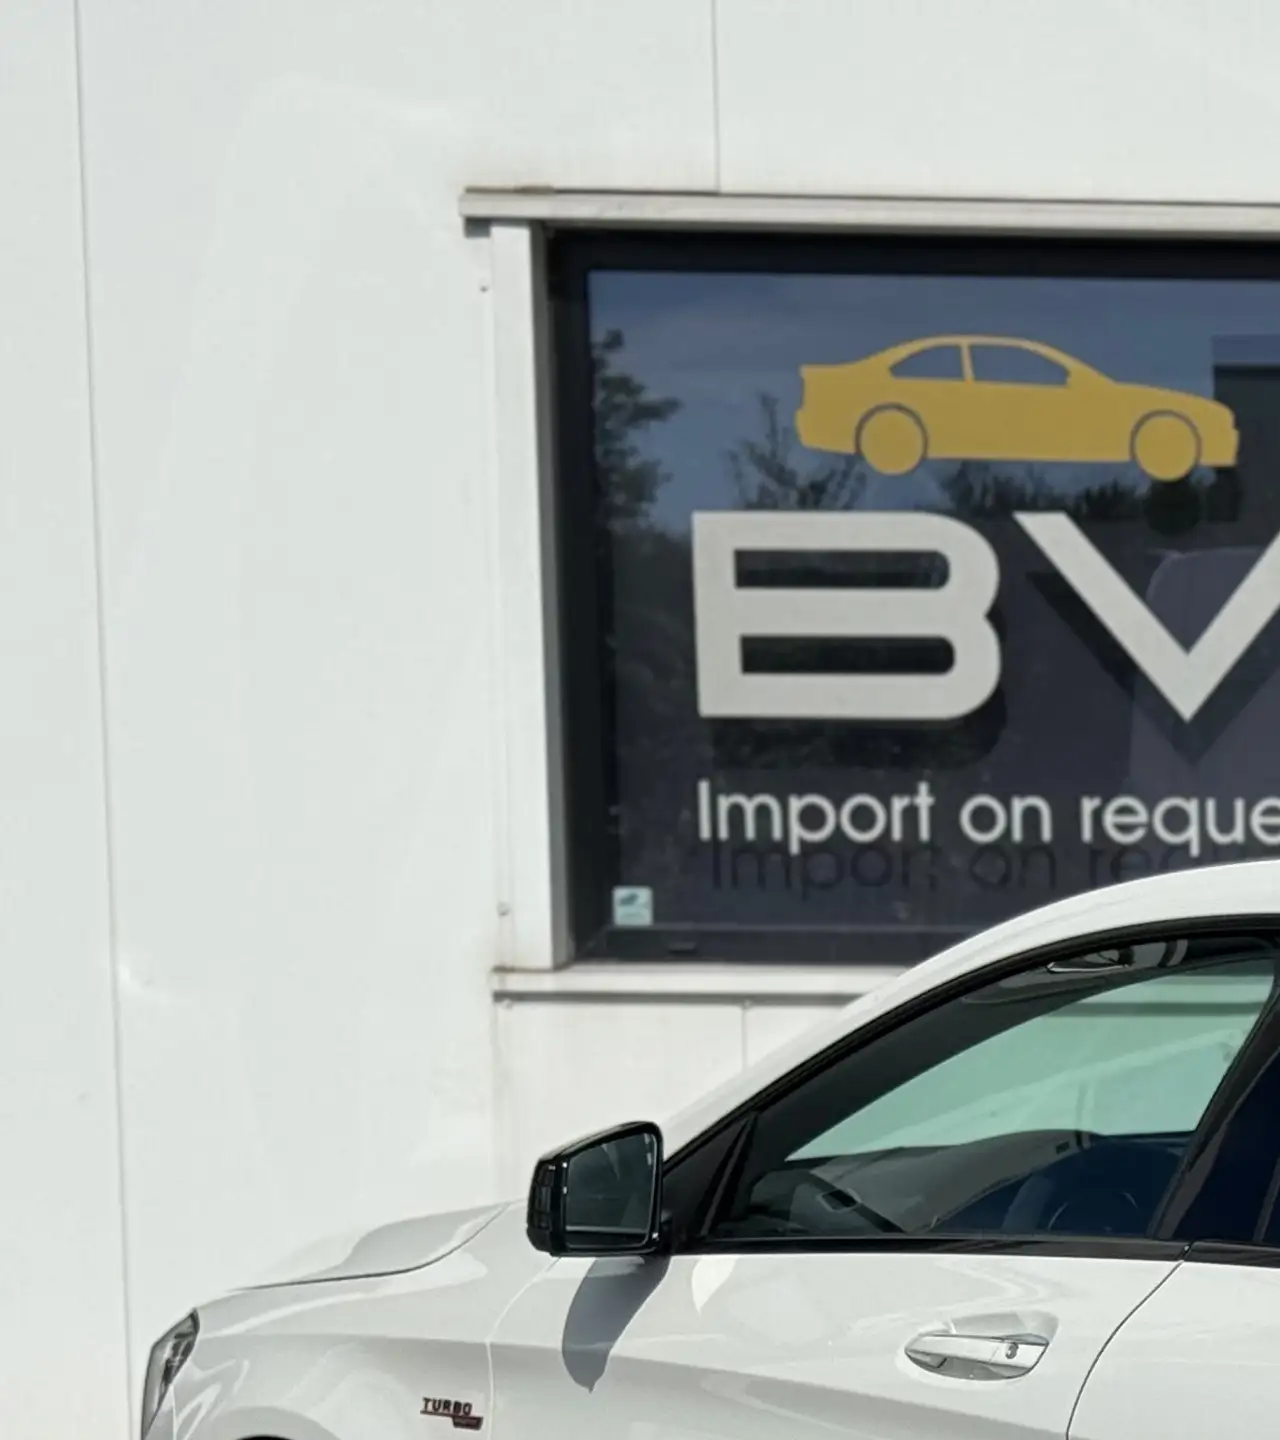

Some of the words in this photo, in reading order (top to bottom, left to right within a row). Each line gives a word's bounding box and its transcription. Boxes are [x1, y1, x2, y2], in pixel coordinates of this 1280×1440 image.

[697, 780, 935, 856] Import
[959, 796, 1054, 844] on
[421, 1397, 473, 1416] TURBO
